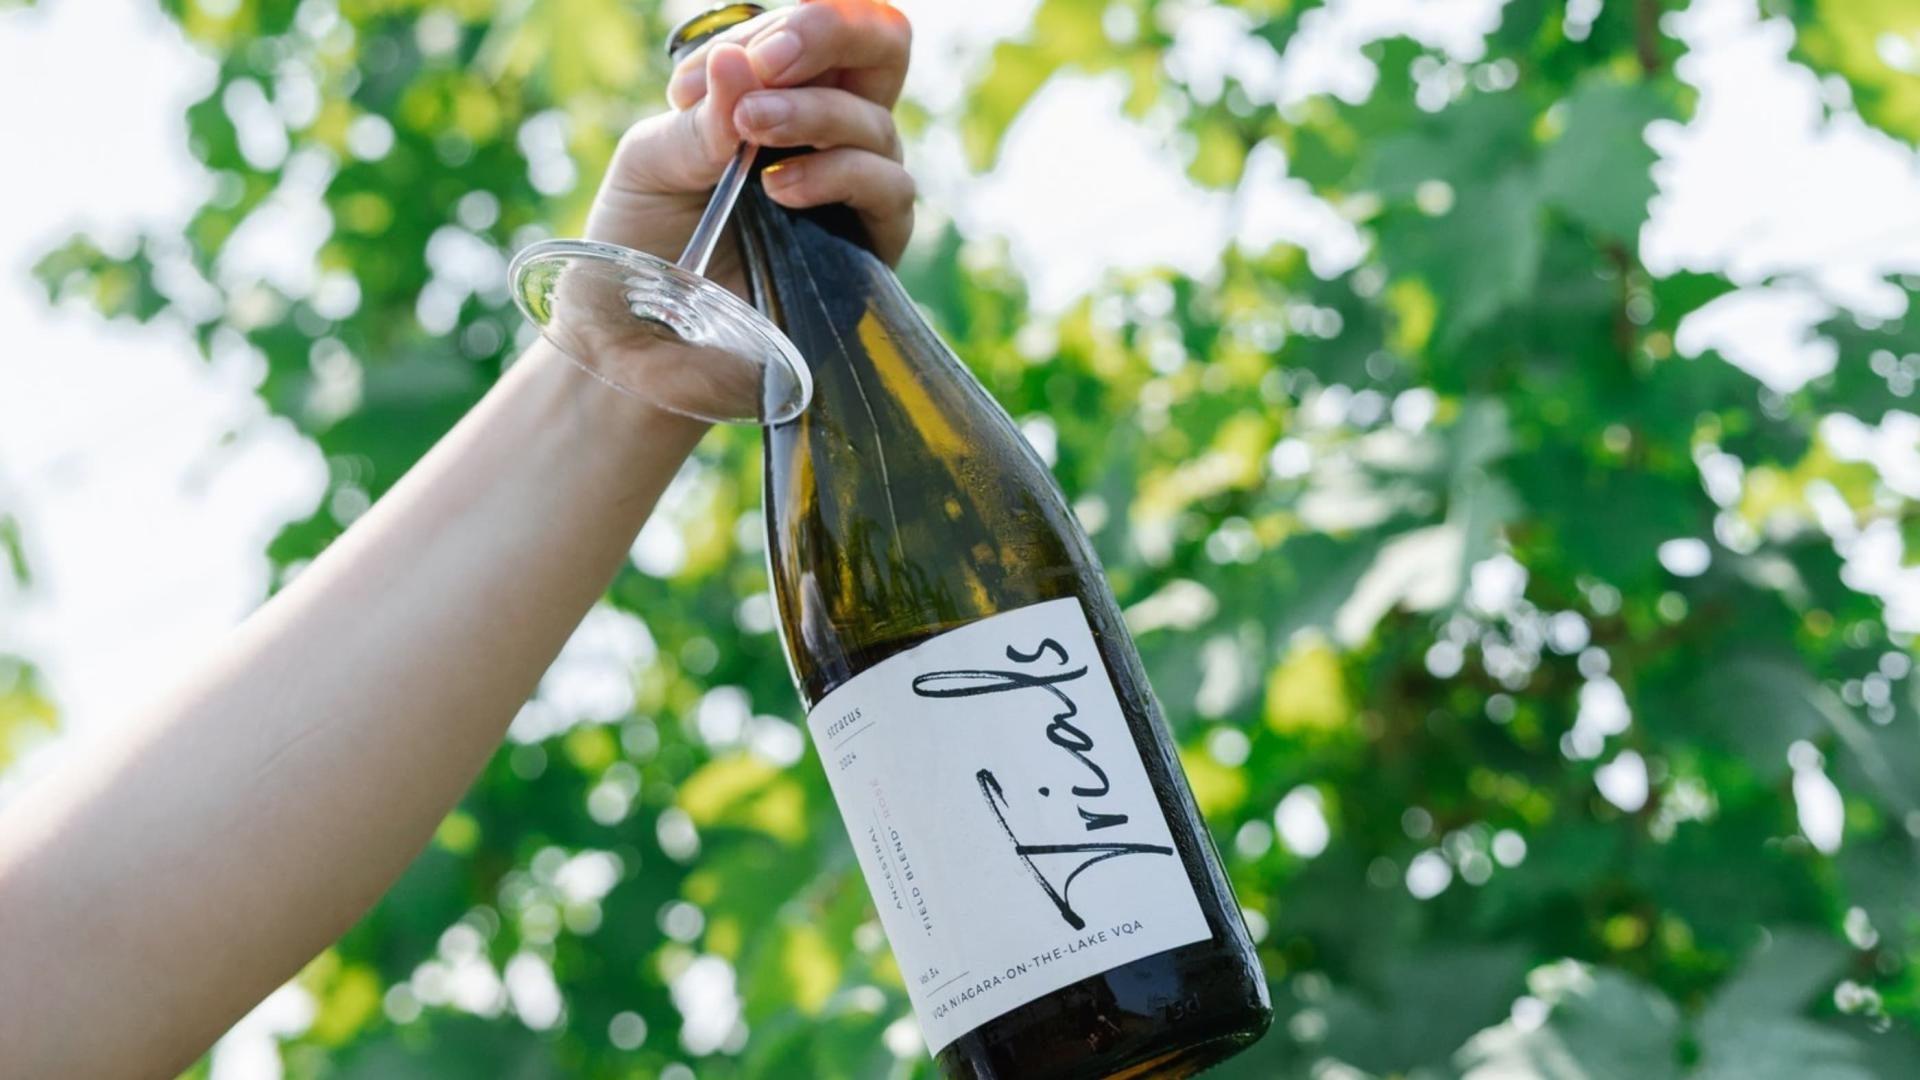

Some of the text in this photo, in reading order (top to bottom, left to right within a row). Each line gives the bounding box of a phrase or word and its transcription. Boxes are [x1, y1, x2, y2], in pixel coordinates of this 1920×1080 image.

[826, 707, 862, 739] stratus
[911, 637, 1173, 930] Trials
[868, 825, 903, 910] ANCESTRAL
[950, 931, 1108, 1009] NIAGARA-ON-THE-LAKE
[1111, 919, 1144, 937] VQA
